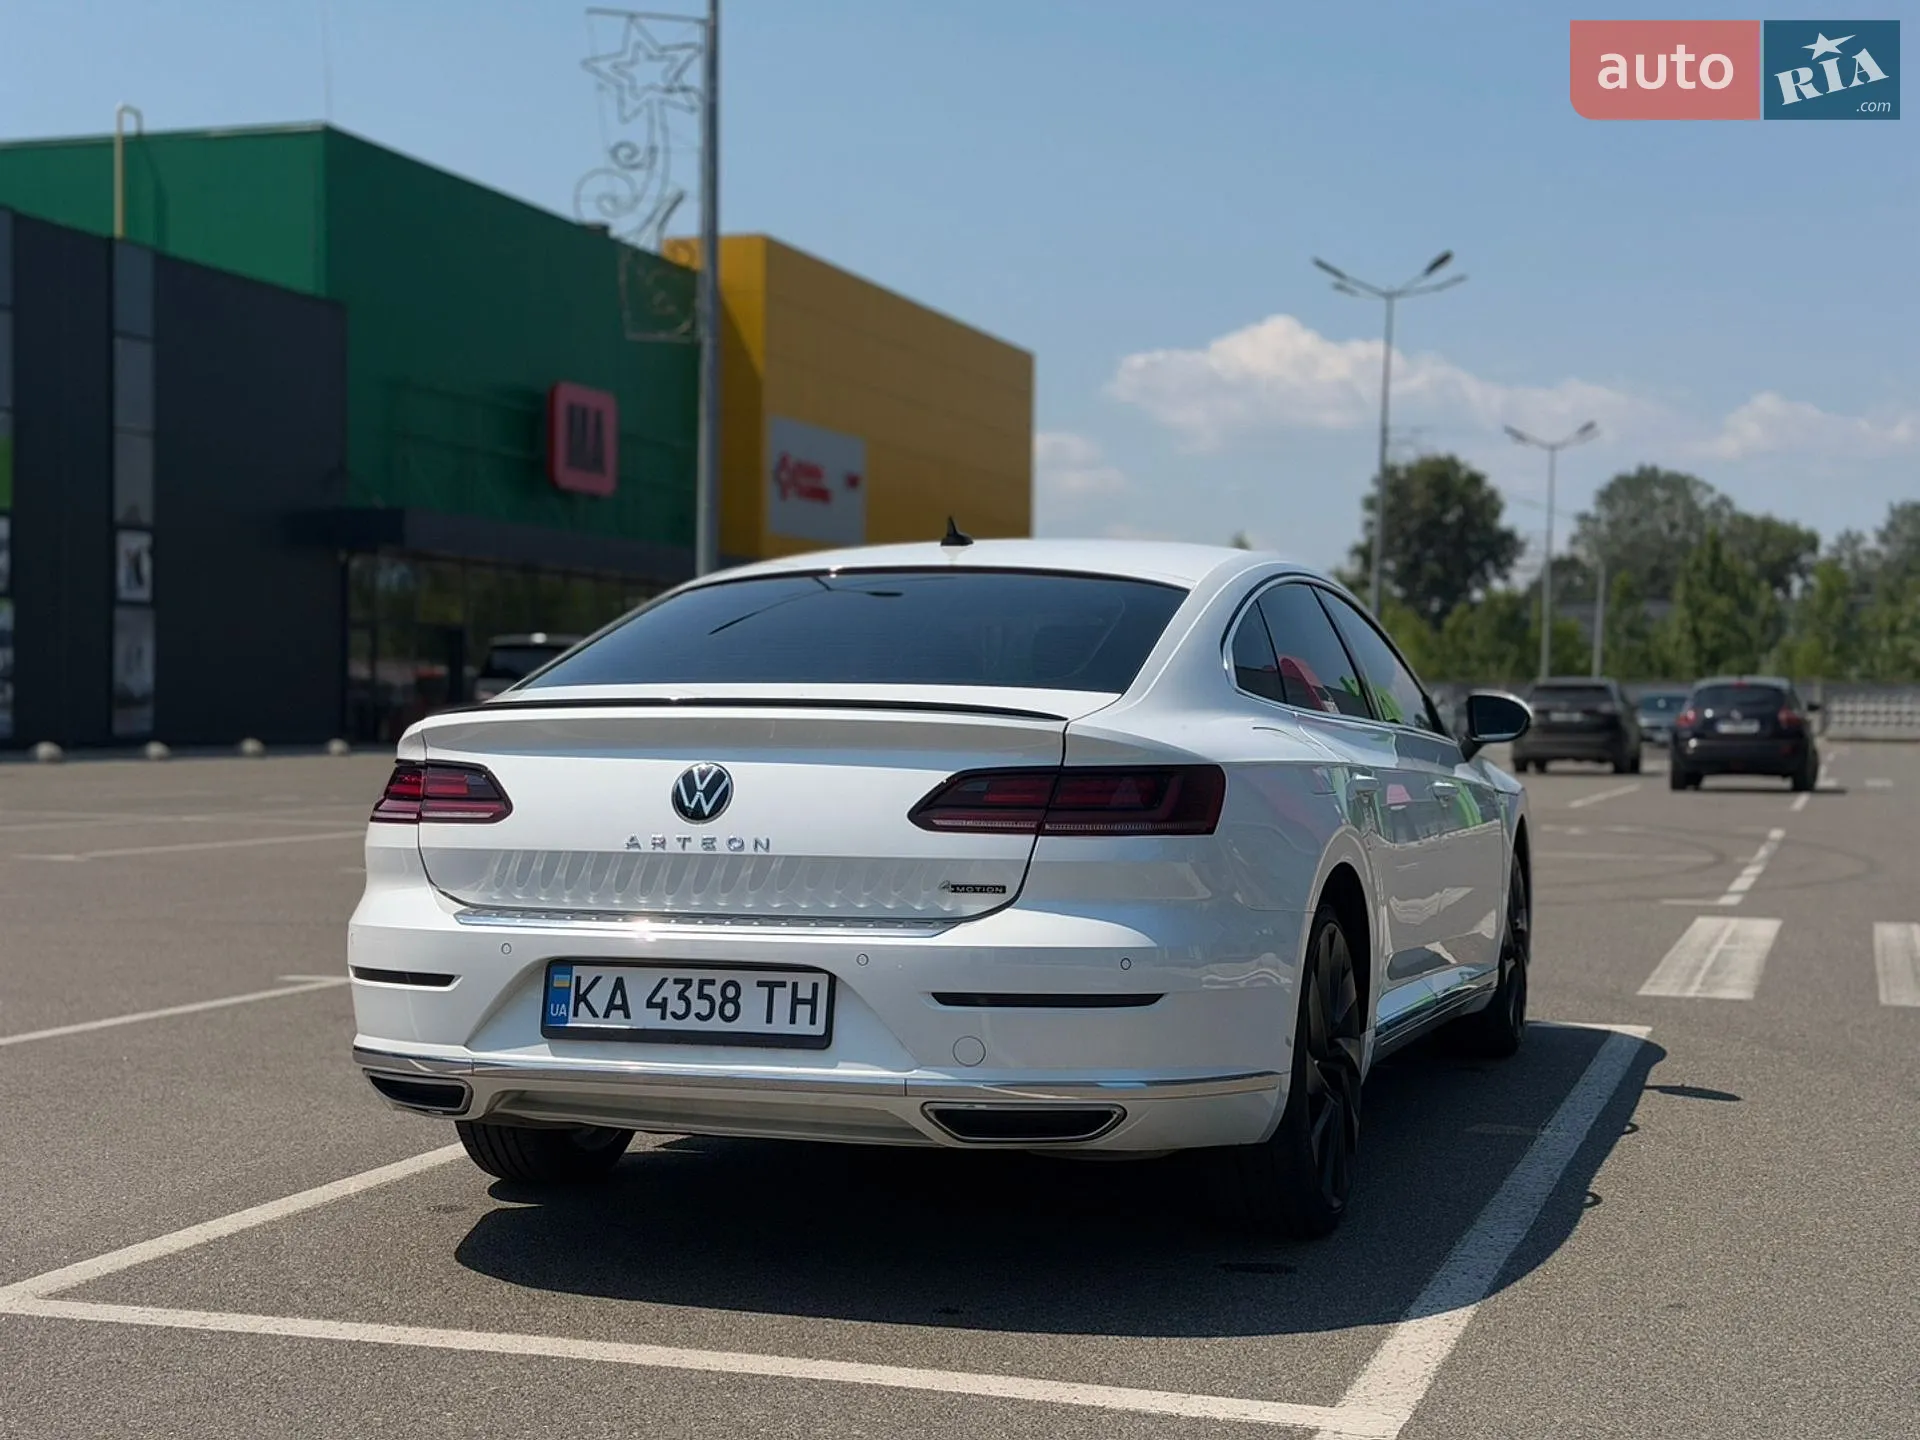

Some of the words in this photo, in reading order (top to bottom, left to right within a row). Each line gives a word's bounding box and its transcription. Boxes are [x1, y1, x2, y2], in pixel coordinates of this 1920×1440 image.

[625, 834, 771, 853] ARTEON
[550, 1003, 567, 1017] UA
[572, 975, 631, 1020] KA
[646, 977, 742, 1023] 4358
[756, 980, 819, 1026] TH
